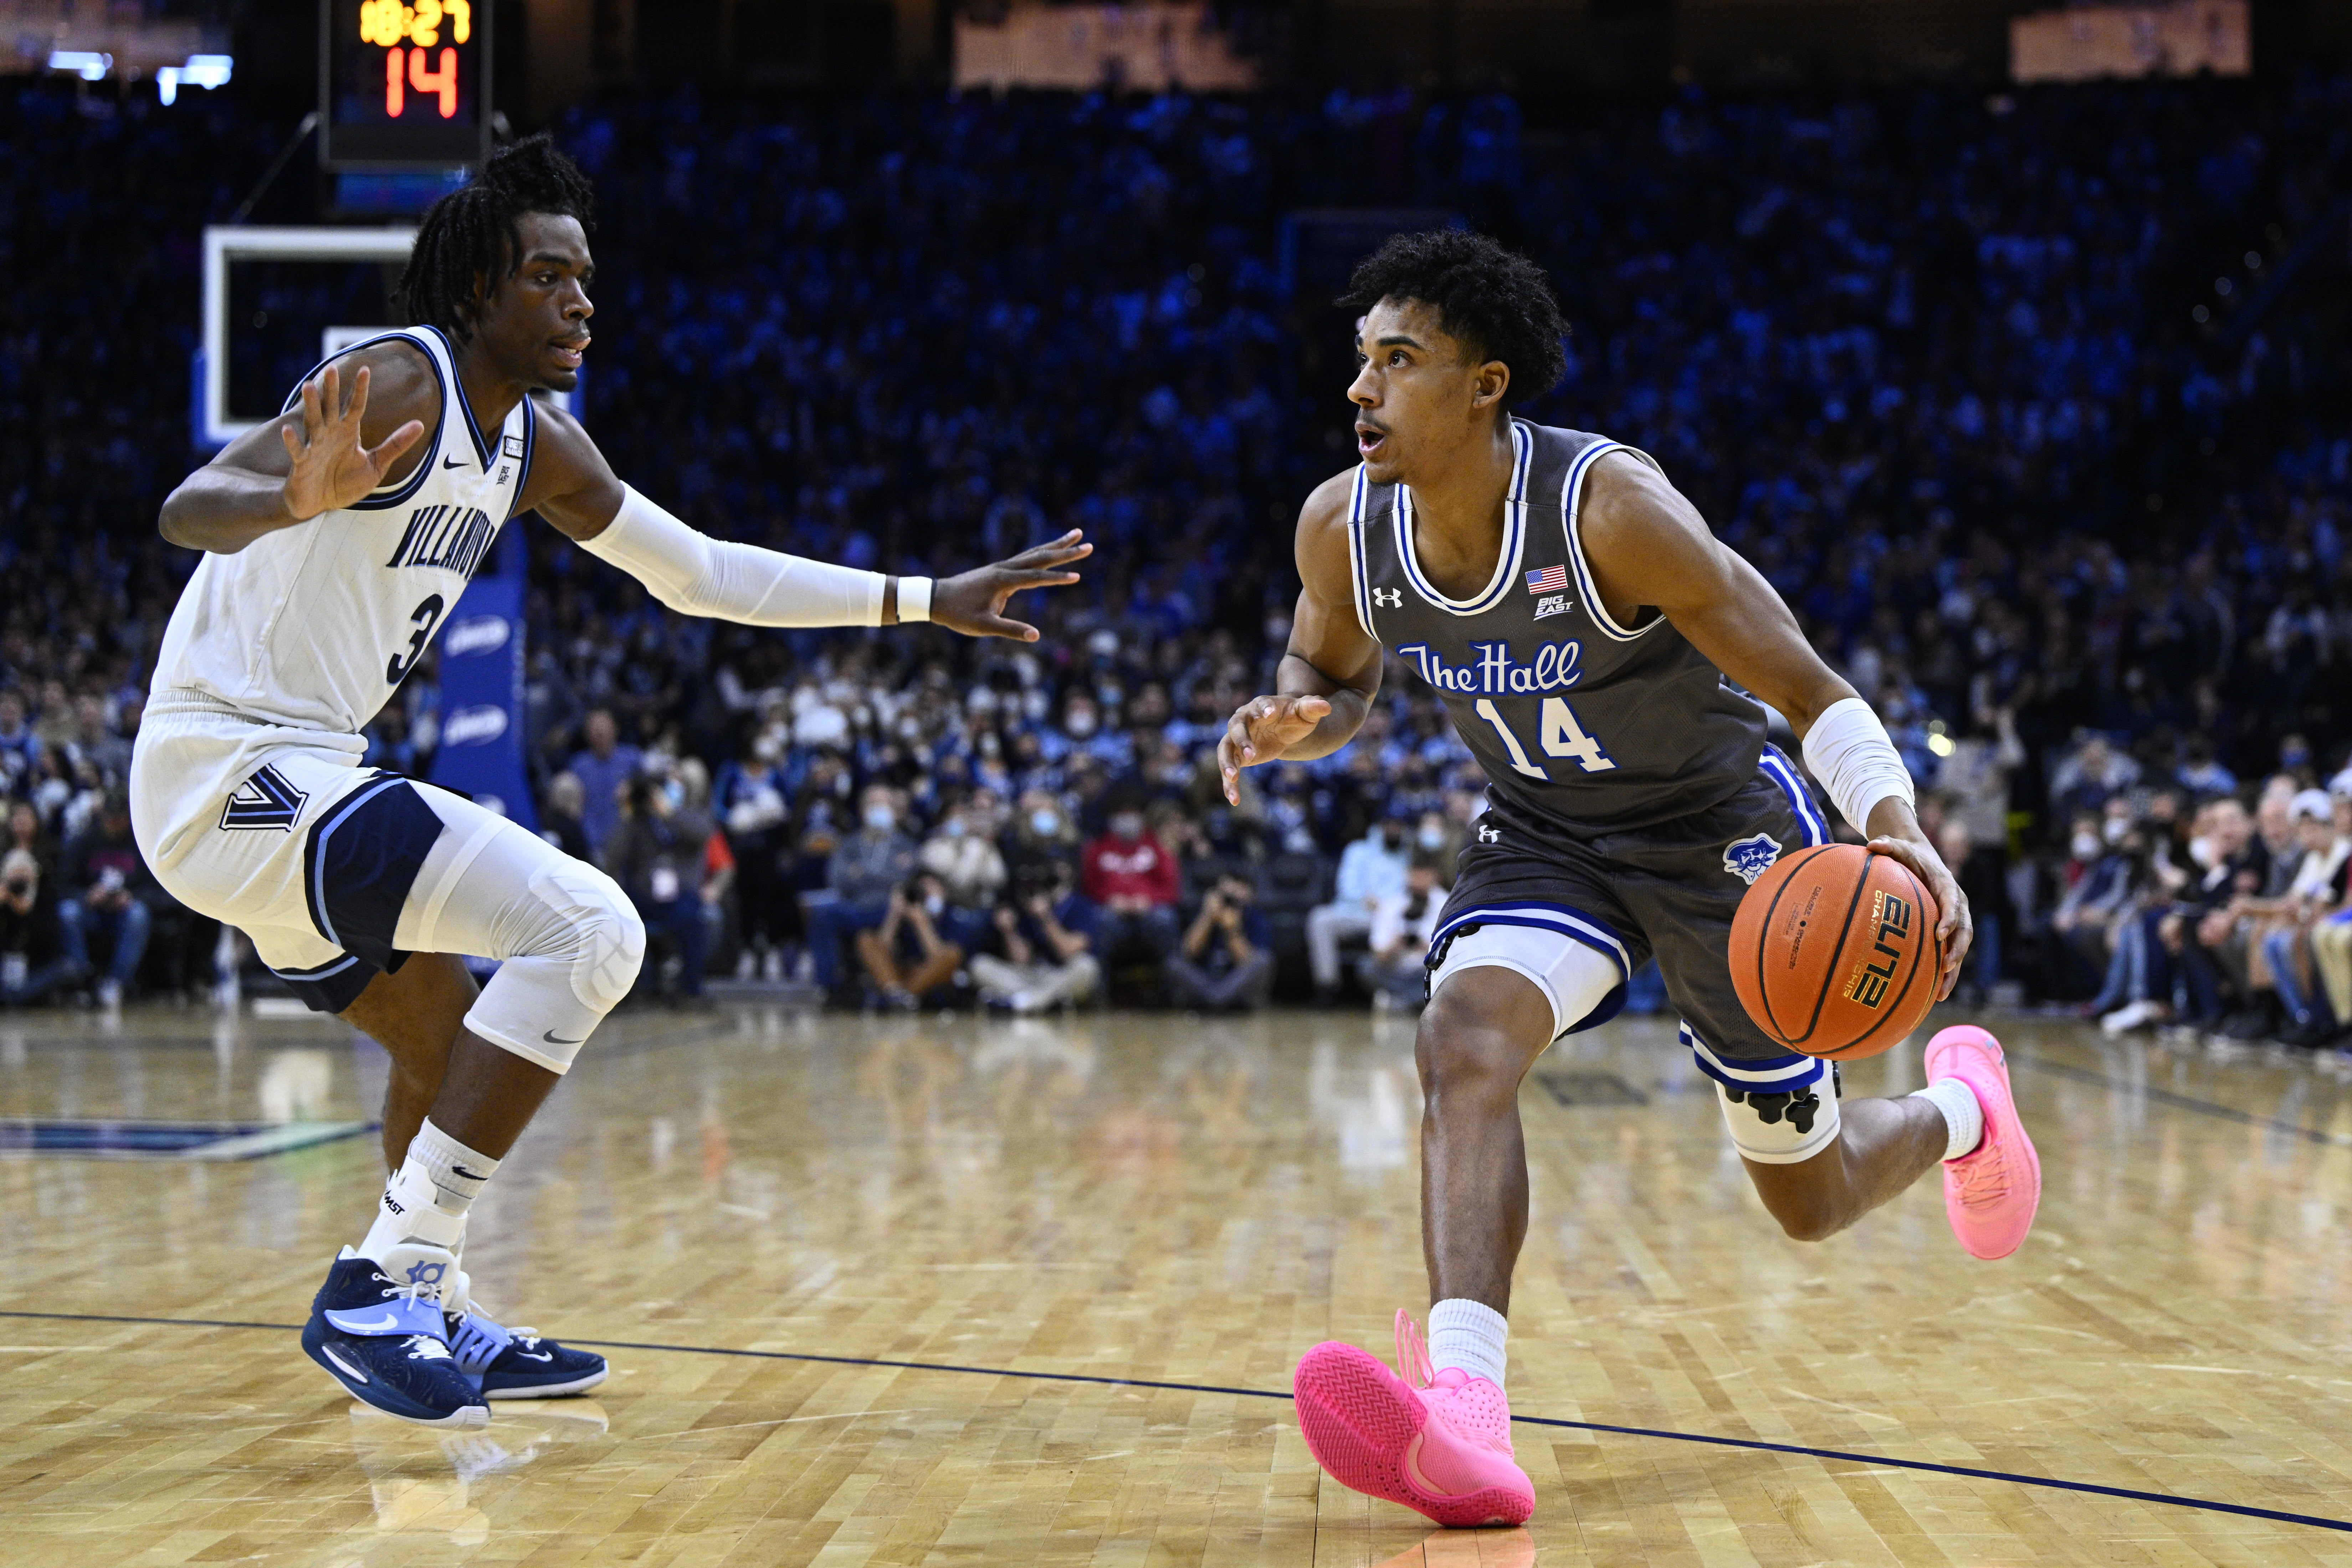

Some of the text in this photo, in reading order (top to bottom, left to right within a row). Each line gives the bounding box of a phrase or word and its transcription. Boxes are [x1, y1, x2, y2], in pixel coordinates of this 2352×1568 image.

[386, 47, 457, 118] 14
[1535, 602, 1573, 616] EAST
[1537, 595, 1564, 608] BIG
[386, 593, 444, 686] 3
[1398, 640, 1582, 695] The Hall
[1475, 696, 1619, 781] 14
[1851, 892, 1912, 1010] ELITE
[384, 1189, 405, 1215] AMST
